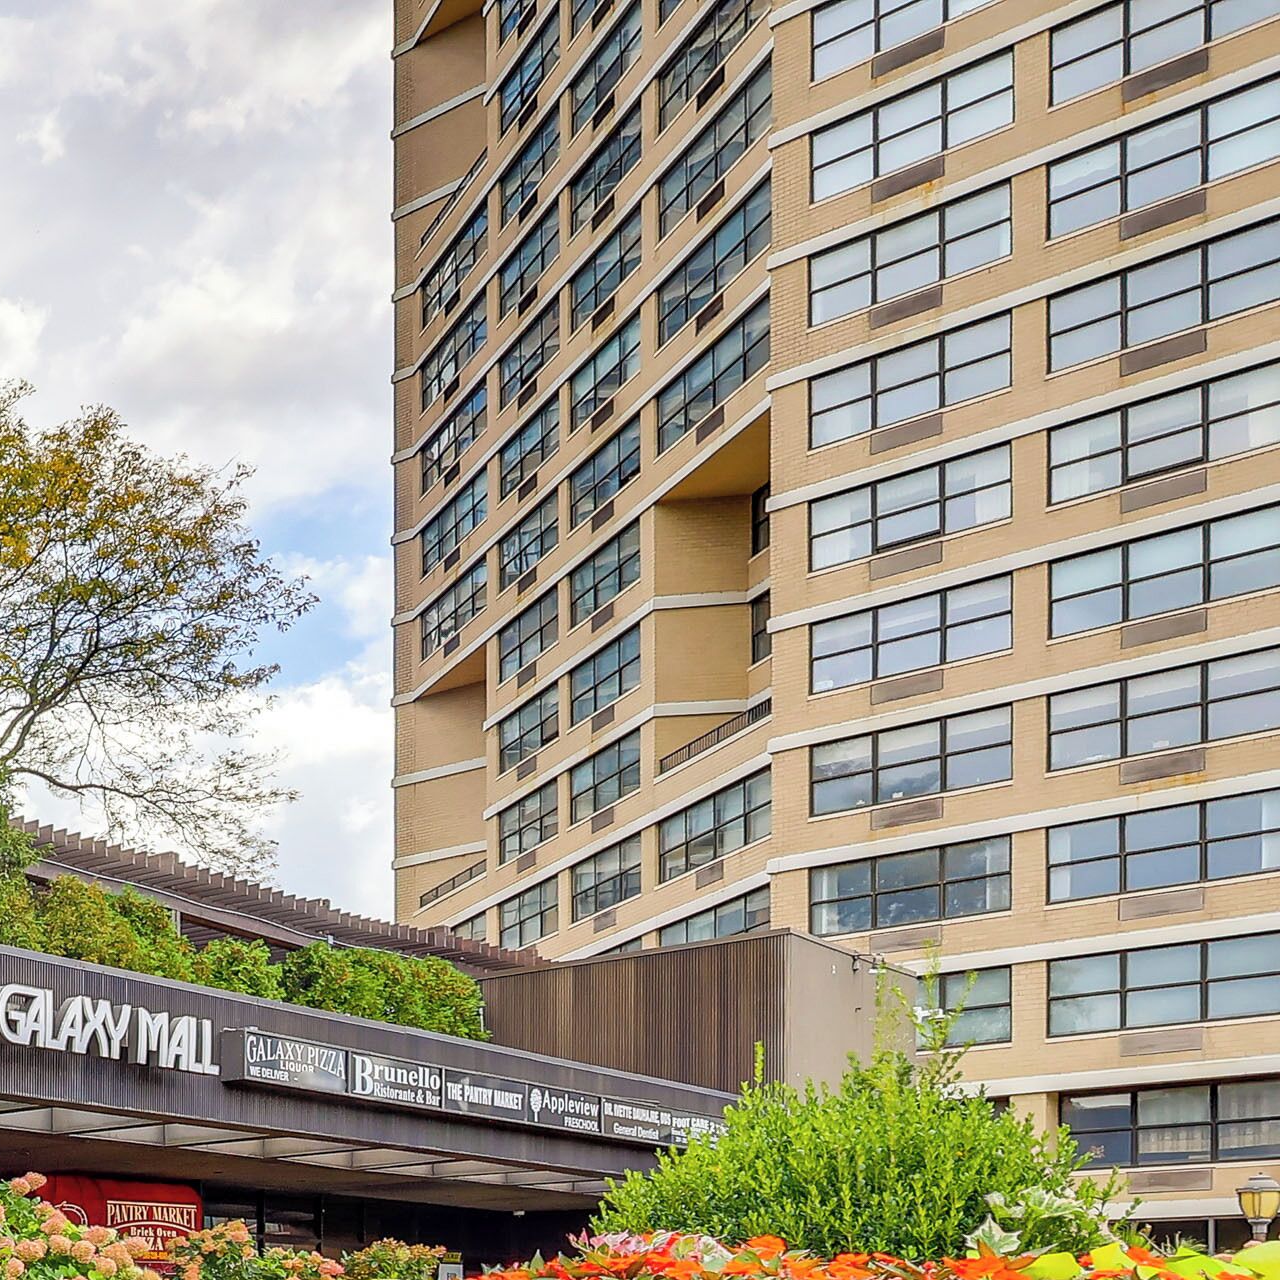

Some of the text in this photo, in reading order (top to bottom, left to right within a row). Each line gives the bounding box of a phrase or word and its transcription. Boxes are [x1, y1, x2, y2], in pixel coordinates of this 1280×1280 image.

[138, 1007, 220, 1076] MALL
[246, 1034, 345, 1080] GALAXY PIZZA
[280, 1060, 314, 1073] LIQUOR
[249, 1065, 289, 1082] WE DELIVER
[353, 1054, 440, 1095] Brunello
[373, 1082, 440, 1106] Ristorante & Bar
[446, 1082, 523, 1110] THE PANTRY MARKET
[543, 1089, 599, 1117] Appleview
[564, 1116, 599, 1132] PRESCHOOL
[613, 1122, 637, 1136] General
[107, 1203, 197, 1229] PANTRY MARKET
[130, 1226, 177, 1238] Brick Oven
